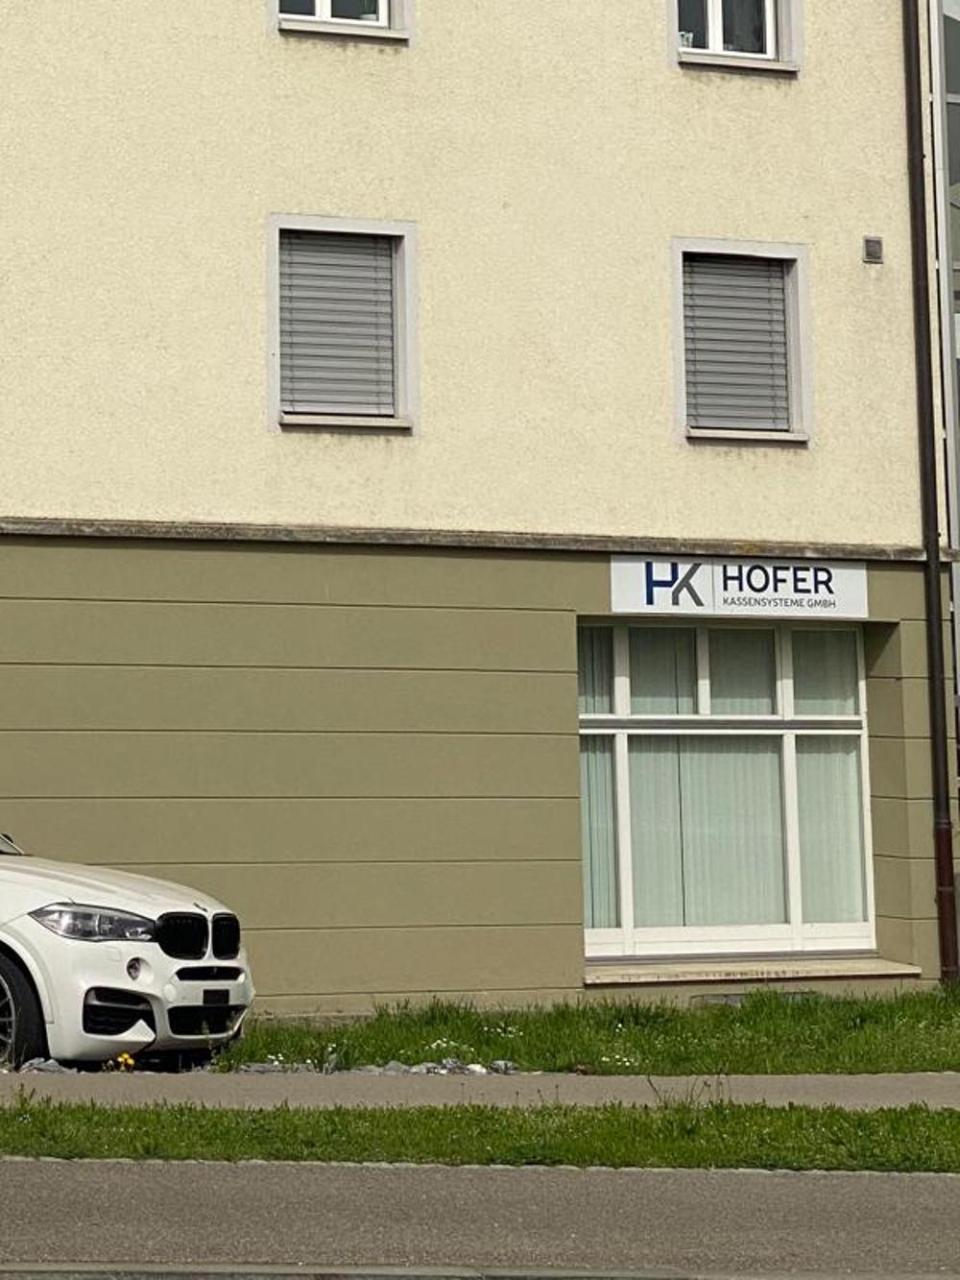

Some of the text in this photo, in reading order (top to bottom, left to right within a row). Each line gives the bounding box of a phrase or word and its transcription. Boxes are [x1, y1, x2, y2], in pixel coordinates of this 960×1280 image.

[645, 561, 705, 607] HK
[722, 564, 834, 595] HOFER
[722, 596, 837, 609] KASSENSYSTEME GMBH
